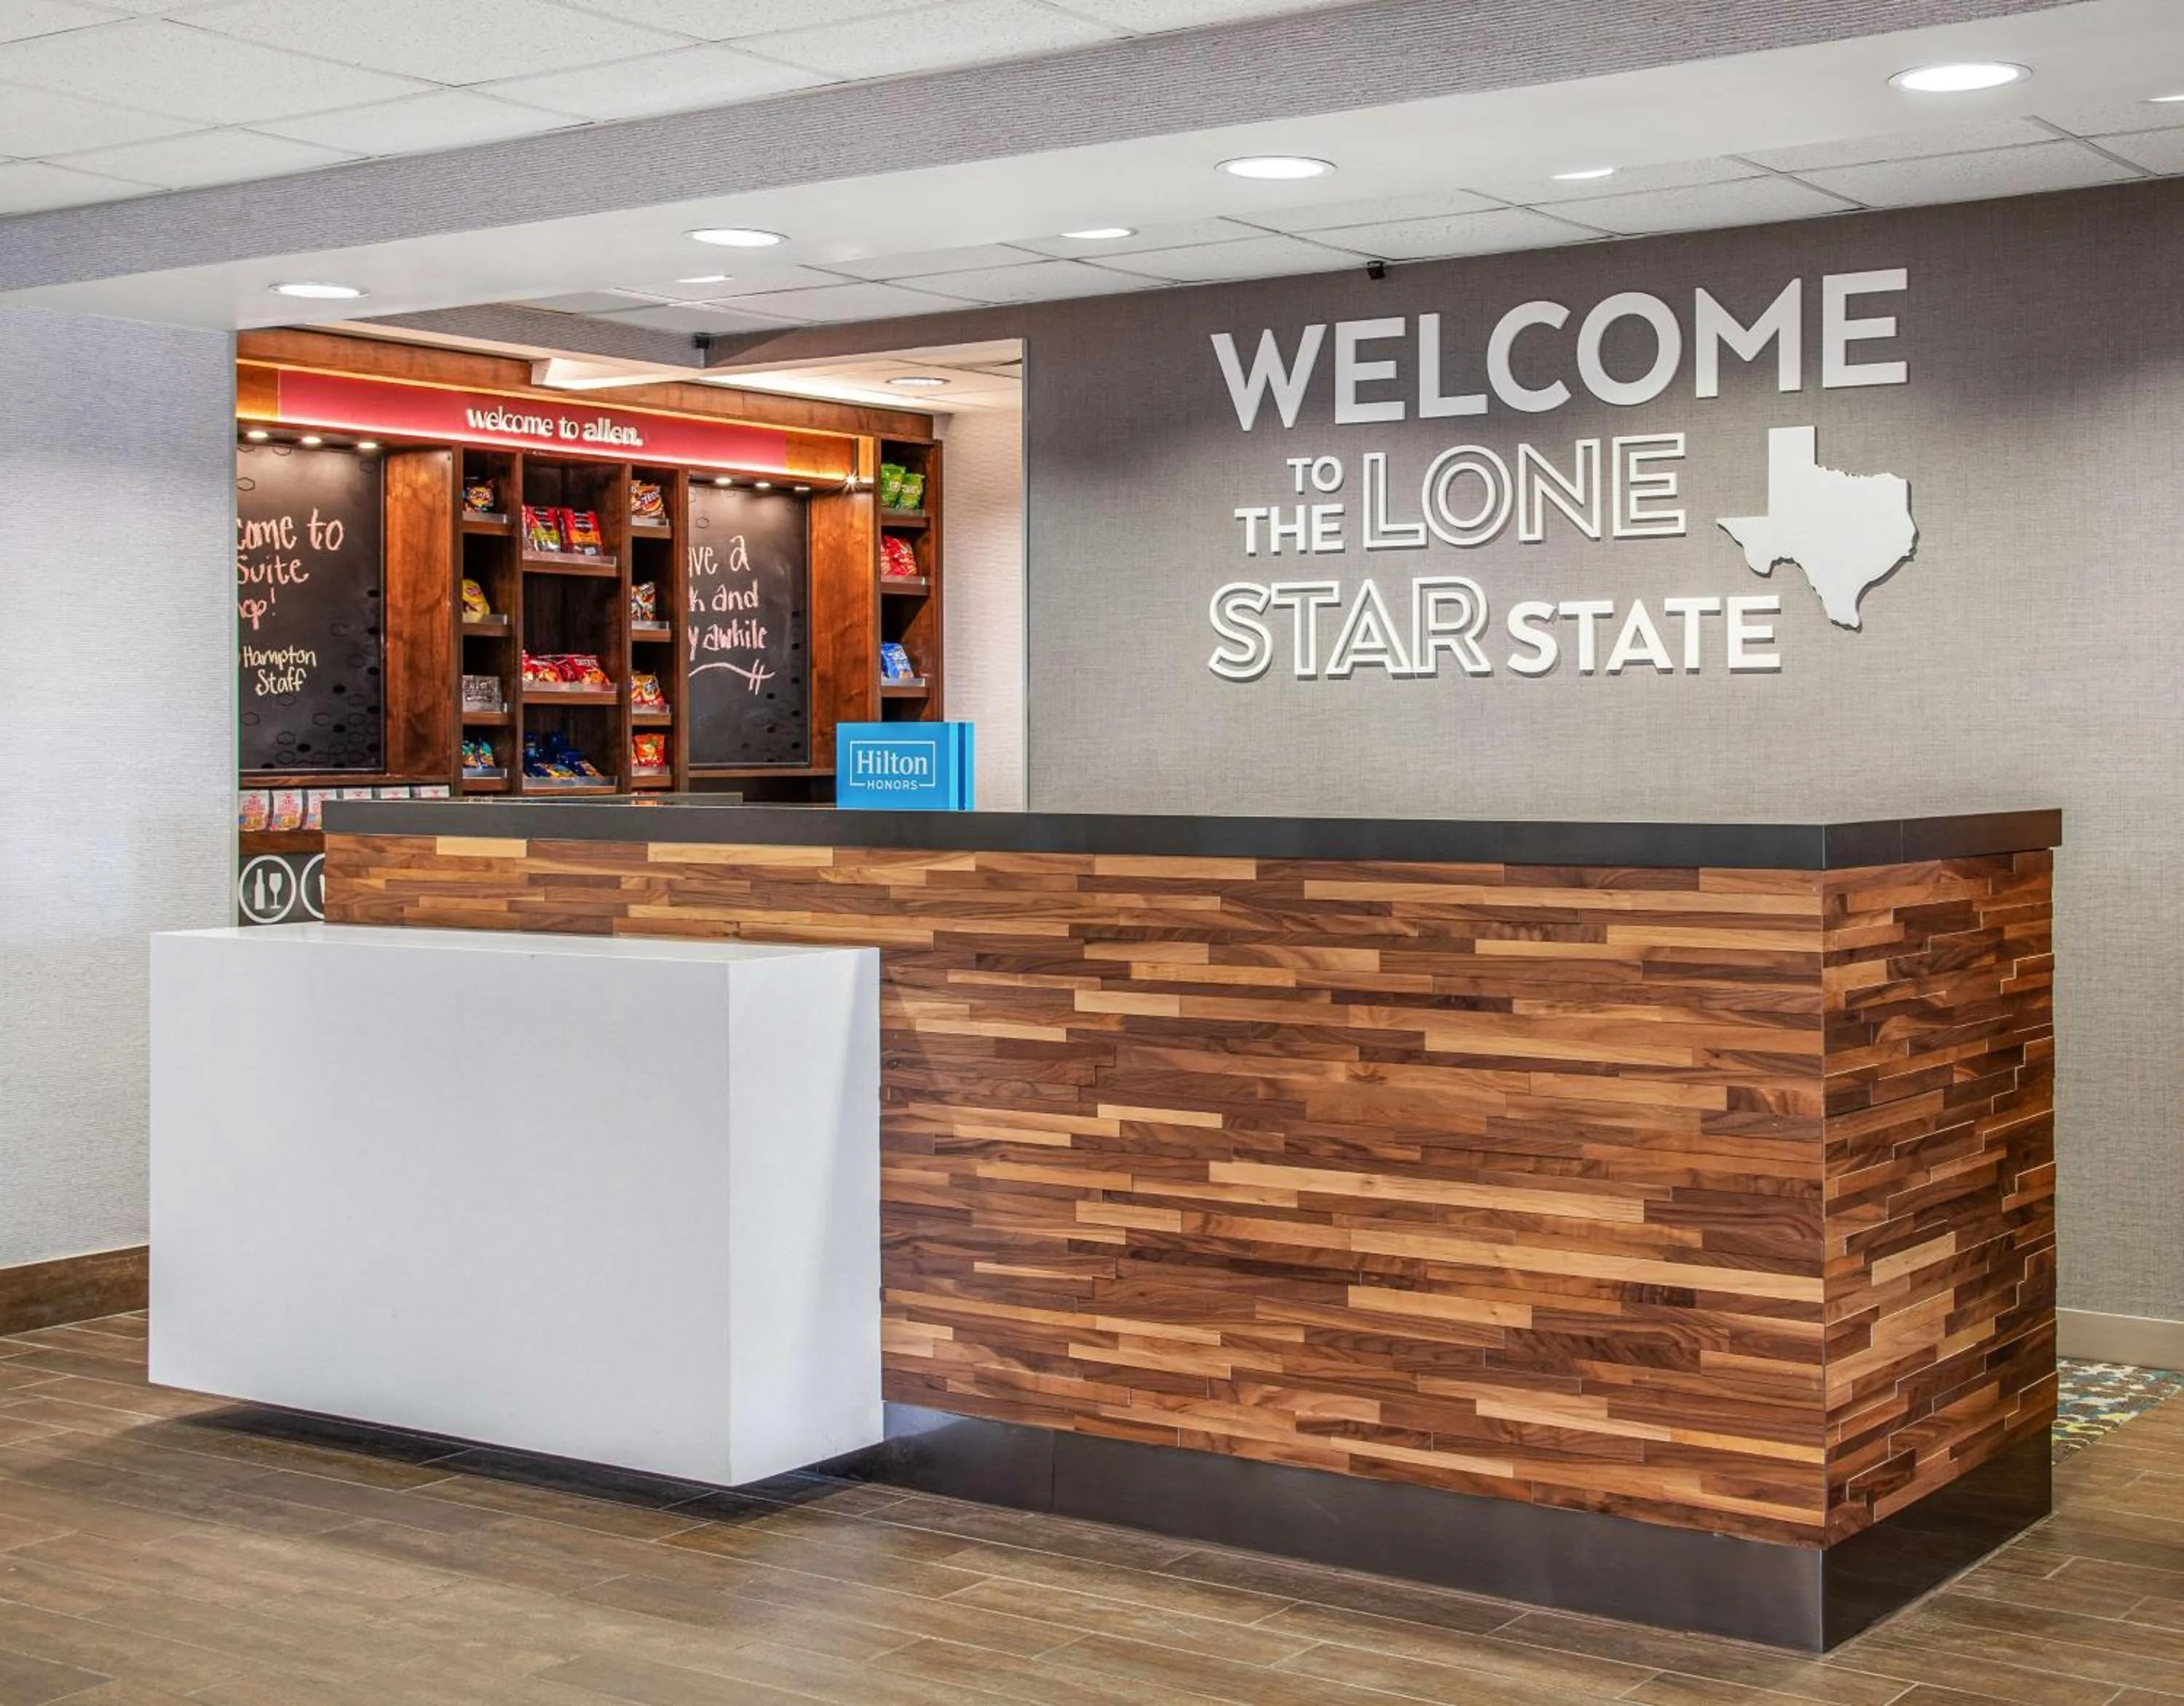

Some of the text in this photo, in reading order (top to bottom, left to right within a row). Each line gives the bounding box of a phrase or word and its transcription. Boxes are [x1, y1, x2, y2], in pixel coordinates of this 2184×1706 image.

[1211, 267, 1908, 431] WELCOME
[466, 406, 644, 446] welcome to allen.
[1286, 456, 1344, 493] TO
[1235, 432, 1687, 555] THE LONE
[306, 507, 345, 551] to
[729, 535, 751, 571] a
[712, 580, 759, 612] and
[703, 618, 768, 651] awhile
[1208, 576, 1783, 681] STAR STATE
[243, 645, 317, 671] Hampton
[256, 666, 307, 697] Staff
[856, 750, 928, 775] Hilton
[866, 779, 919, 790] HONORS
